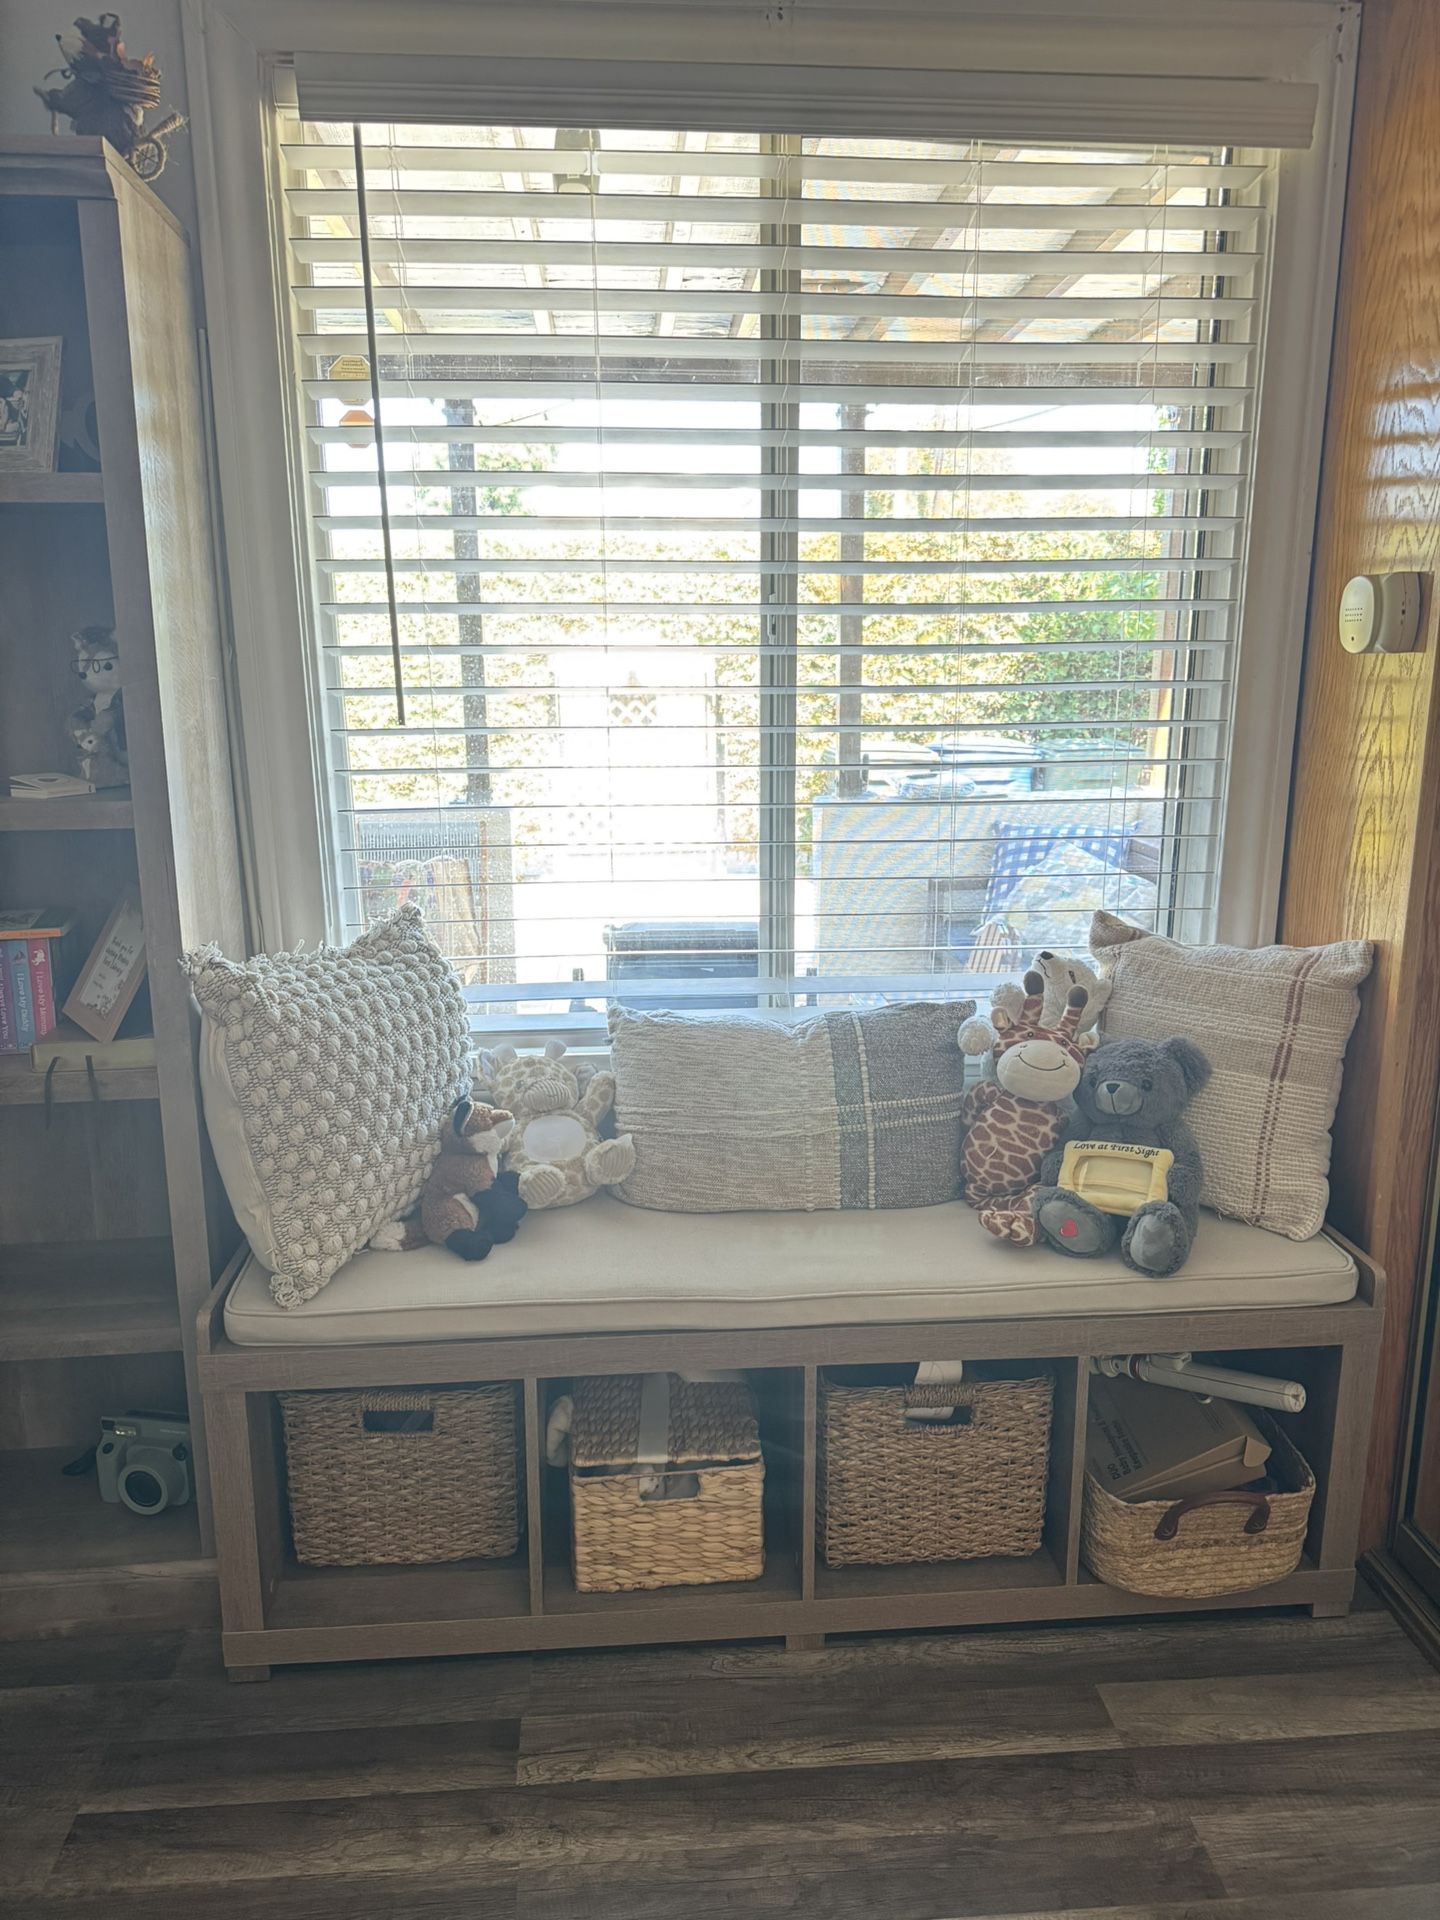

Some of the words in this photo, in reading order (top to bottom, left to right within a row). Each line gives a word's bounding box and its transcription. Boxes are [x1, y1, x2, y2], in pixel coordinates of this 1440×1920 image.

[17, 977, 25, 995] Love
[19, 996, 27, 1008] My
[38, 994, 46, 1006] My
[21, 1009, 29, 1032] Daddy
[1073, 1142, 1096, 1150] Love
[1110, 1144, 1134, 1152] First
[1134, 1146, 1160, 1158] Sight
